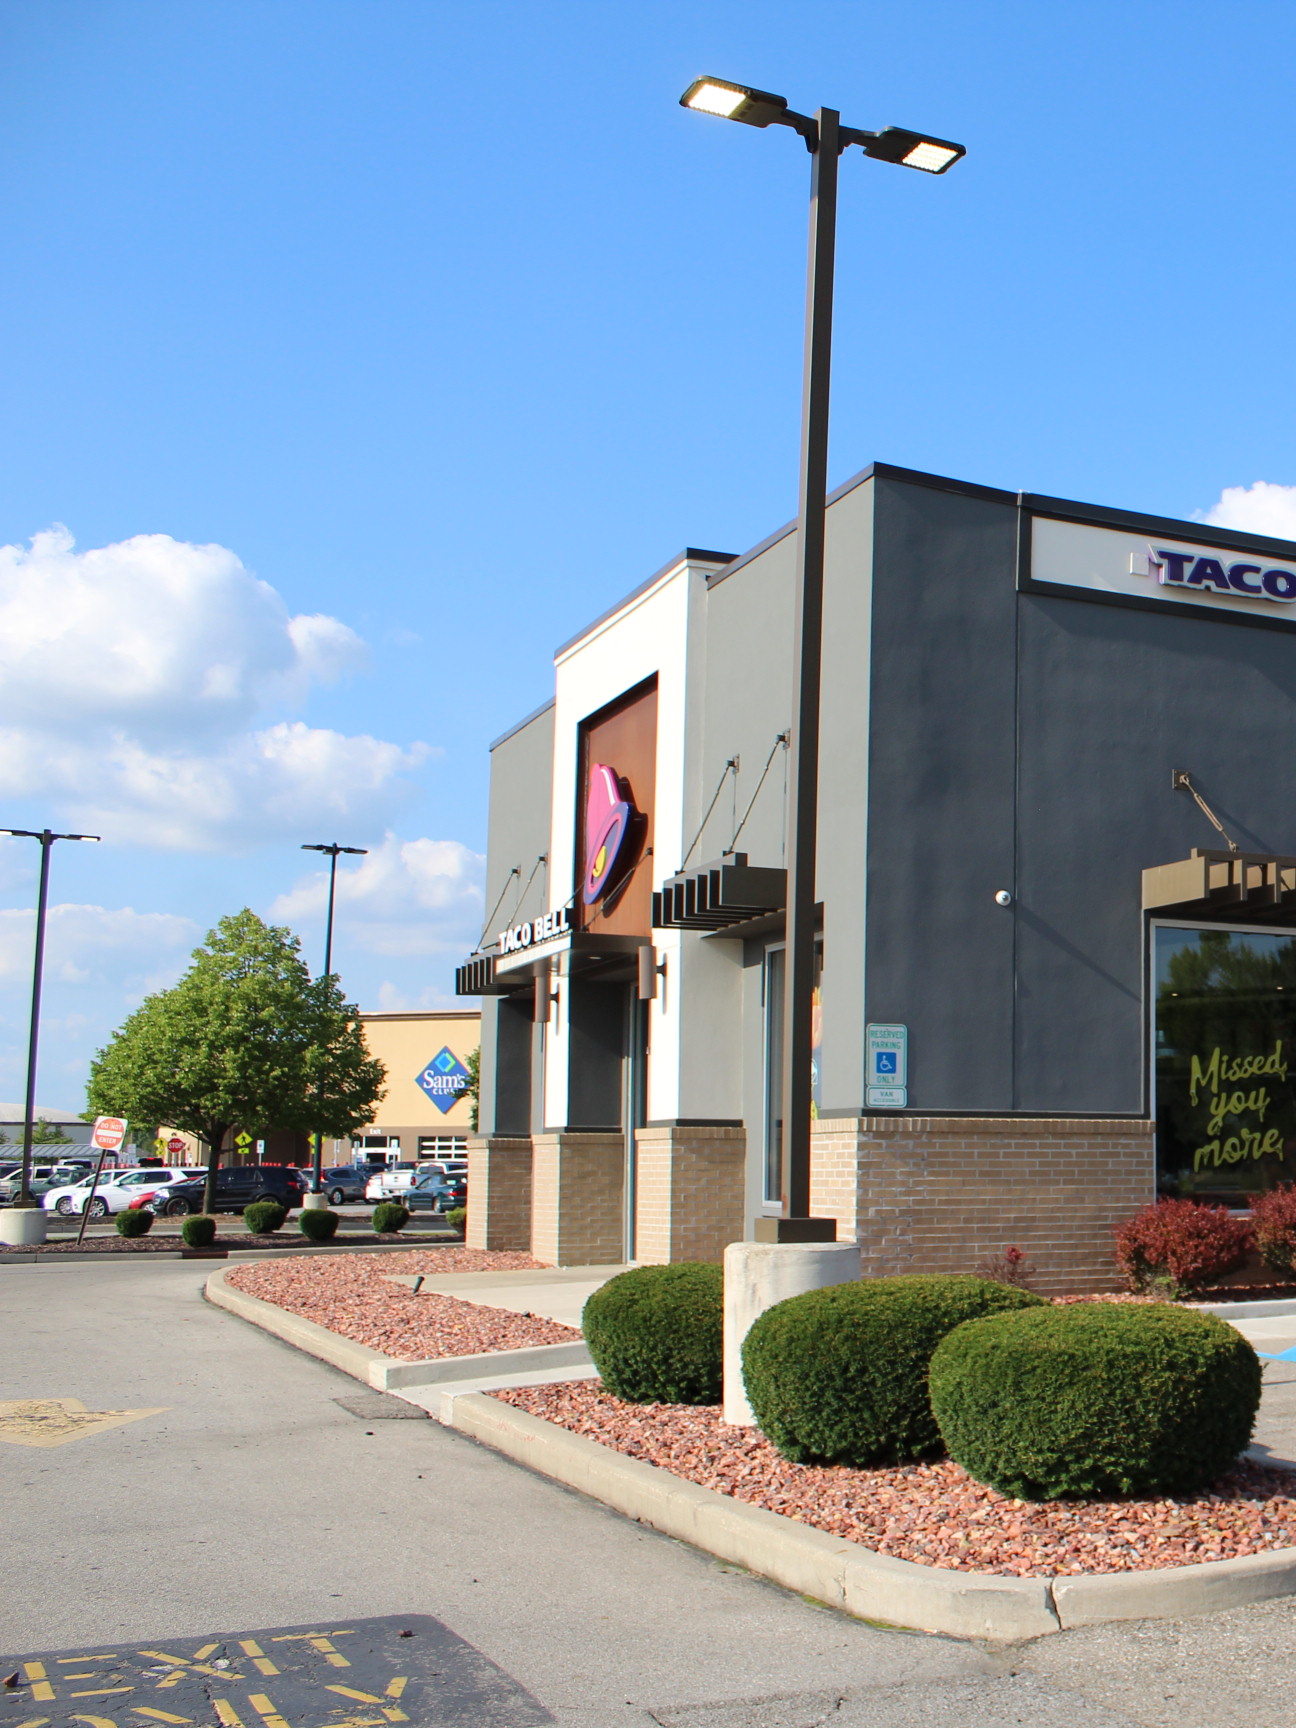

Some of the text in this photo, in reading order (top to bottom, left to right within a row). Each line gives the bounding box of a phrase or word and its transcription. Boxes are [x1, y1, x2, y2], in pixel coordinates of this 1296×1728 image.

[499, 907, 570, 954] TACO BELL
[869, 1030, 904, 1039] RESERVED
[871, 1041, 901, 1049] PARKING
[423, 1069, 466, 1089] Sam's
[876, 1075, 895, 1083] ONLY
[1189, 1039, 1288, 1107] Missed
[1207, 1087, 1271, 1136] you
[1194, 1128, 1285, 1173] more
[23, 1630, 356, 1701] EXIT
